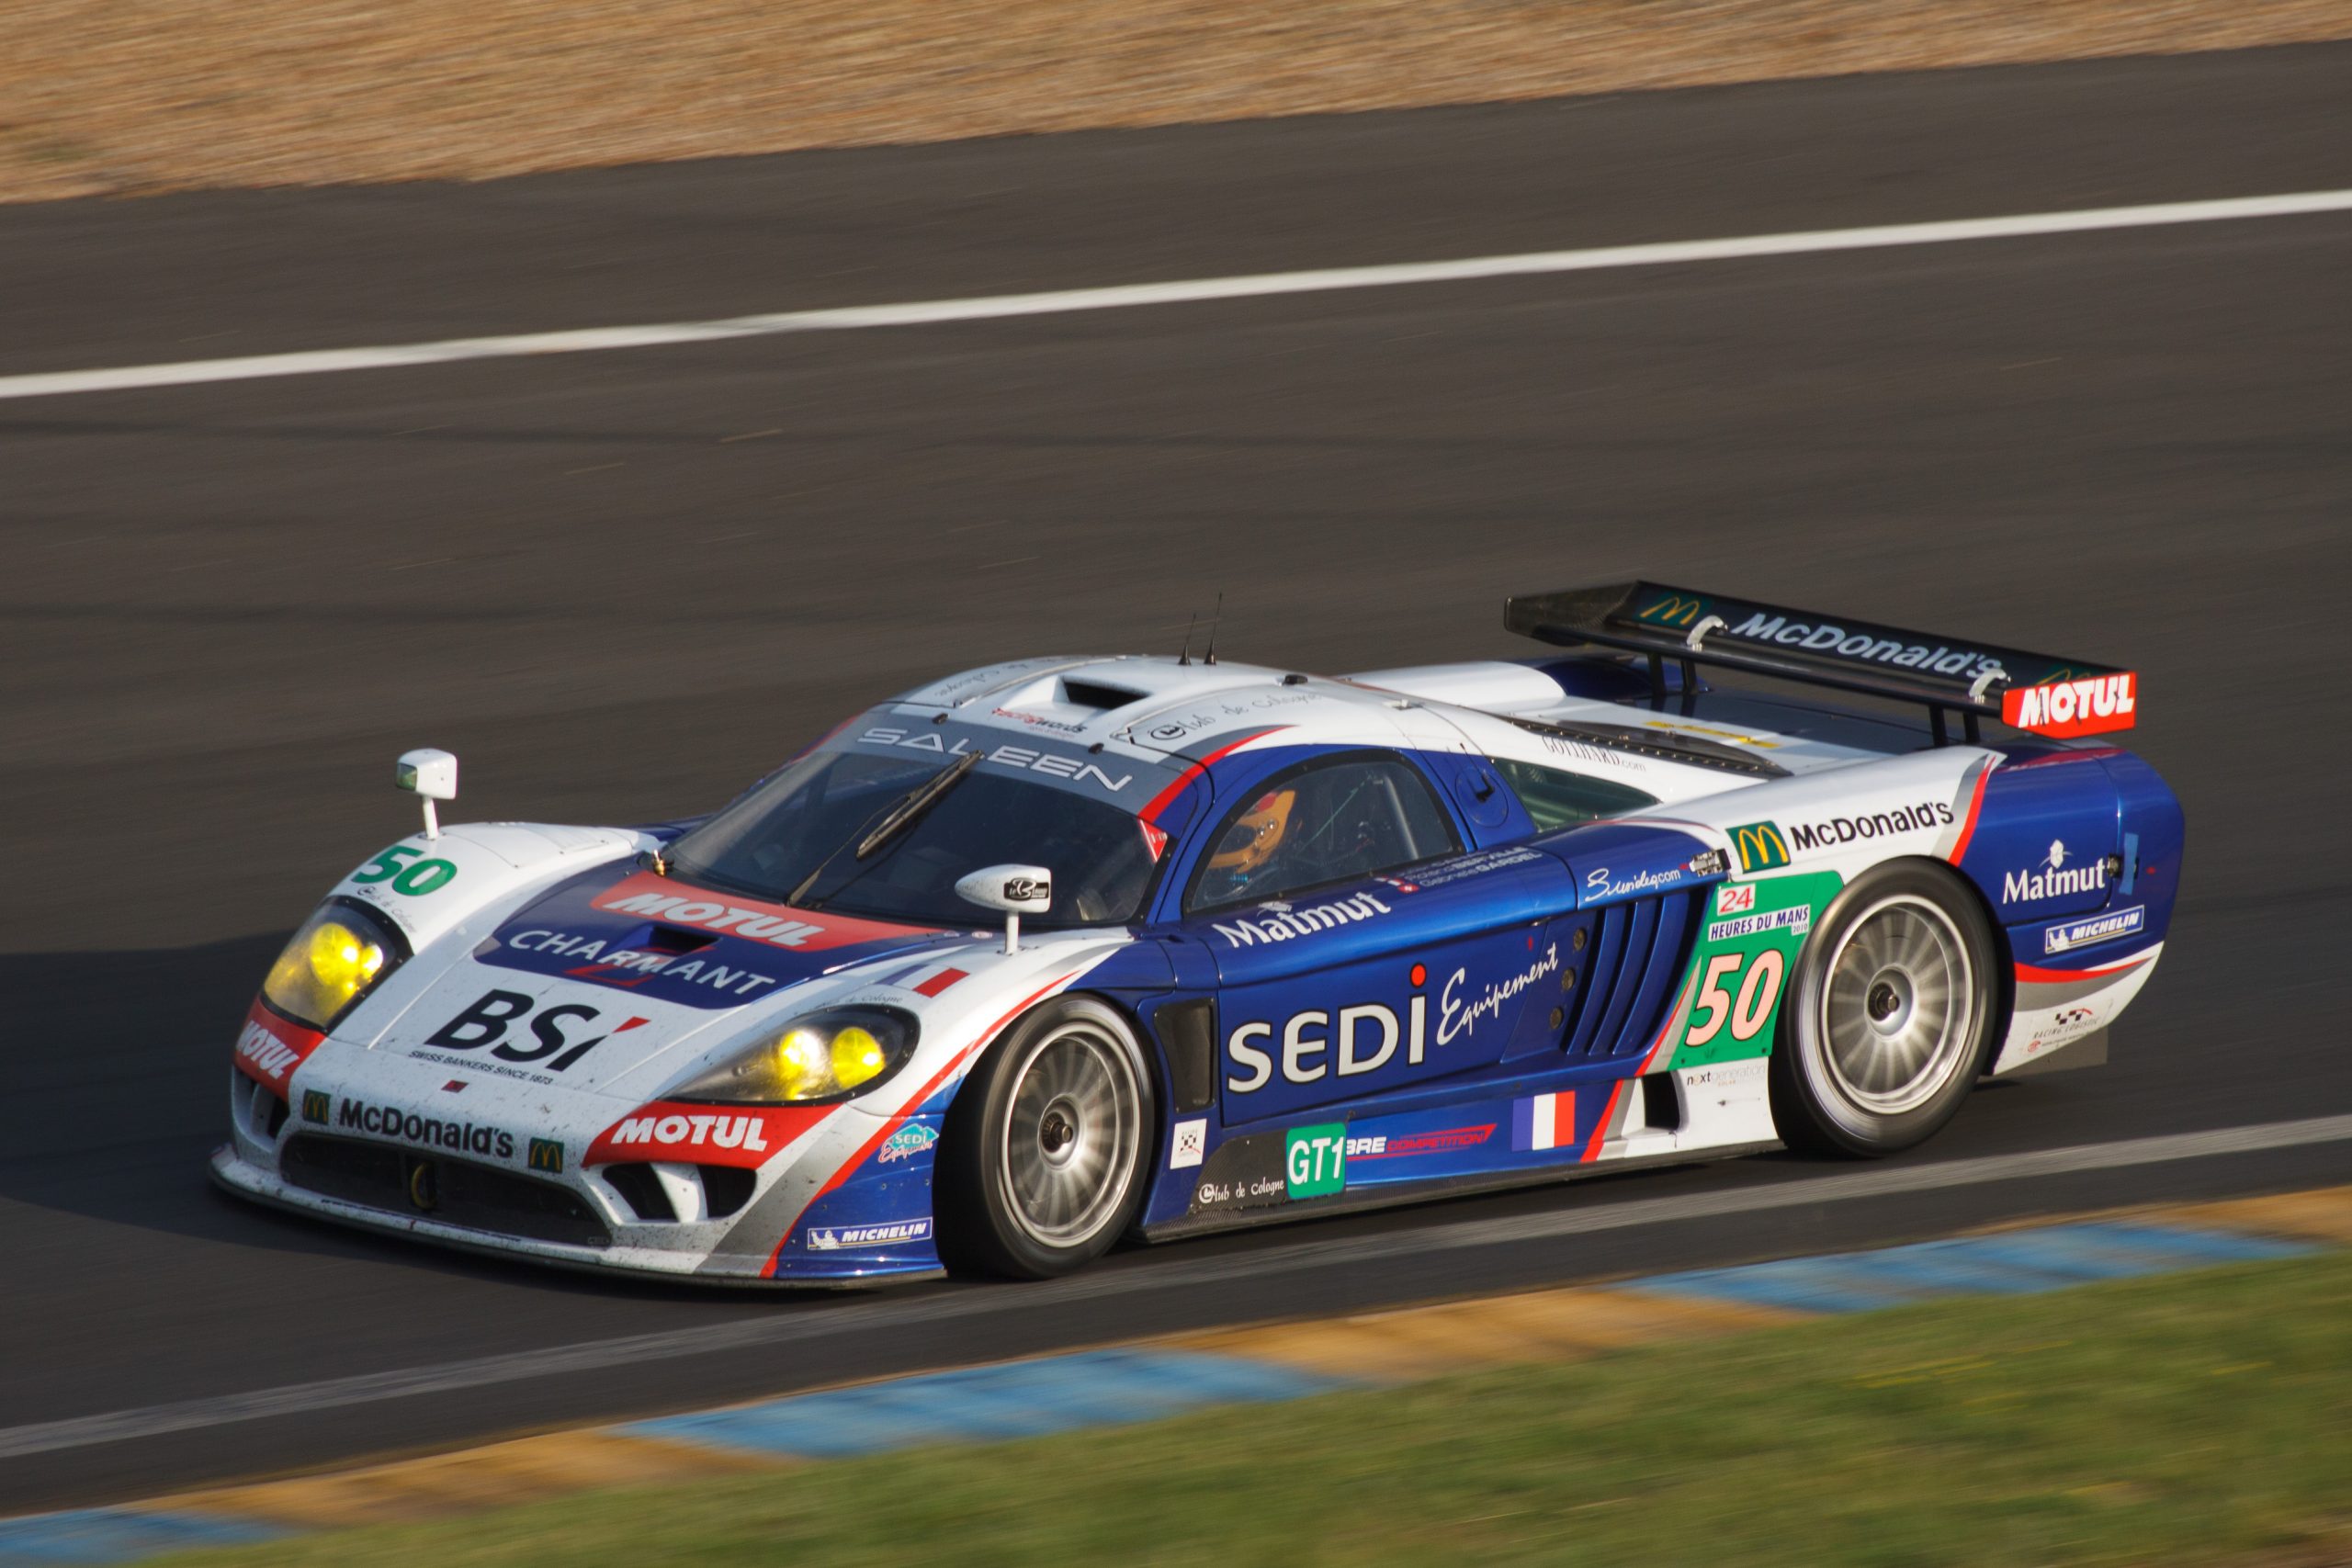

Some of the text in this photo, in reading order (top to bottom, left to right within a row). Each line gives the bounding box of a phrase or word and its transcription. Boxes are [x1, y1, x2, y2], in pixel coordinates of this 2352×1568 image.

[1730, 613, 2004, 678] McDonald's
[2018, 674, 2135, 728] MOTUL
[857, 728, 1133, 792] SALEEN
[1790, 802, 1954, 851] McDonald's
[351, 846, 458, 897] 50
[2002, 857, 2106, 905] Matmut
[603, 893, 825, 947] MOTUL
[1211, 891, 1391, 948] Matmut
[1711, 906, 1809, 940] HEURES DU MANS
[1719, 886, 1754, 913] 24
[1793, 923, 1808, 933] 2010
[2072, 912, 2140, 941] MICHELIN
[509, 930, 776, 995] CHARMANT
[1684, 948, 1784, 1048] 50
[235, 1020, 300, 1079] MOTUL
[409, 1049, 442, 1063] SWISS
[442, 1055, 494, 1074] BANKERS
[493, 1066, 529, 1080] SINCE
[339, 1098, 514, 1159] McDonald's
[611, 1114, 768, 1152] MOTUL
[1386, 1131, 1486, 1152] COMPETITION
[1288, 1135, 1345, 1186] GT1
[1236, 1181, 1246, 1199] de
[842, 1223, 927, 1243] MICHELIN
